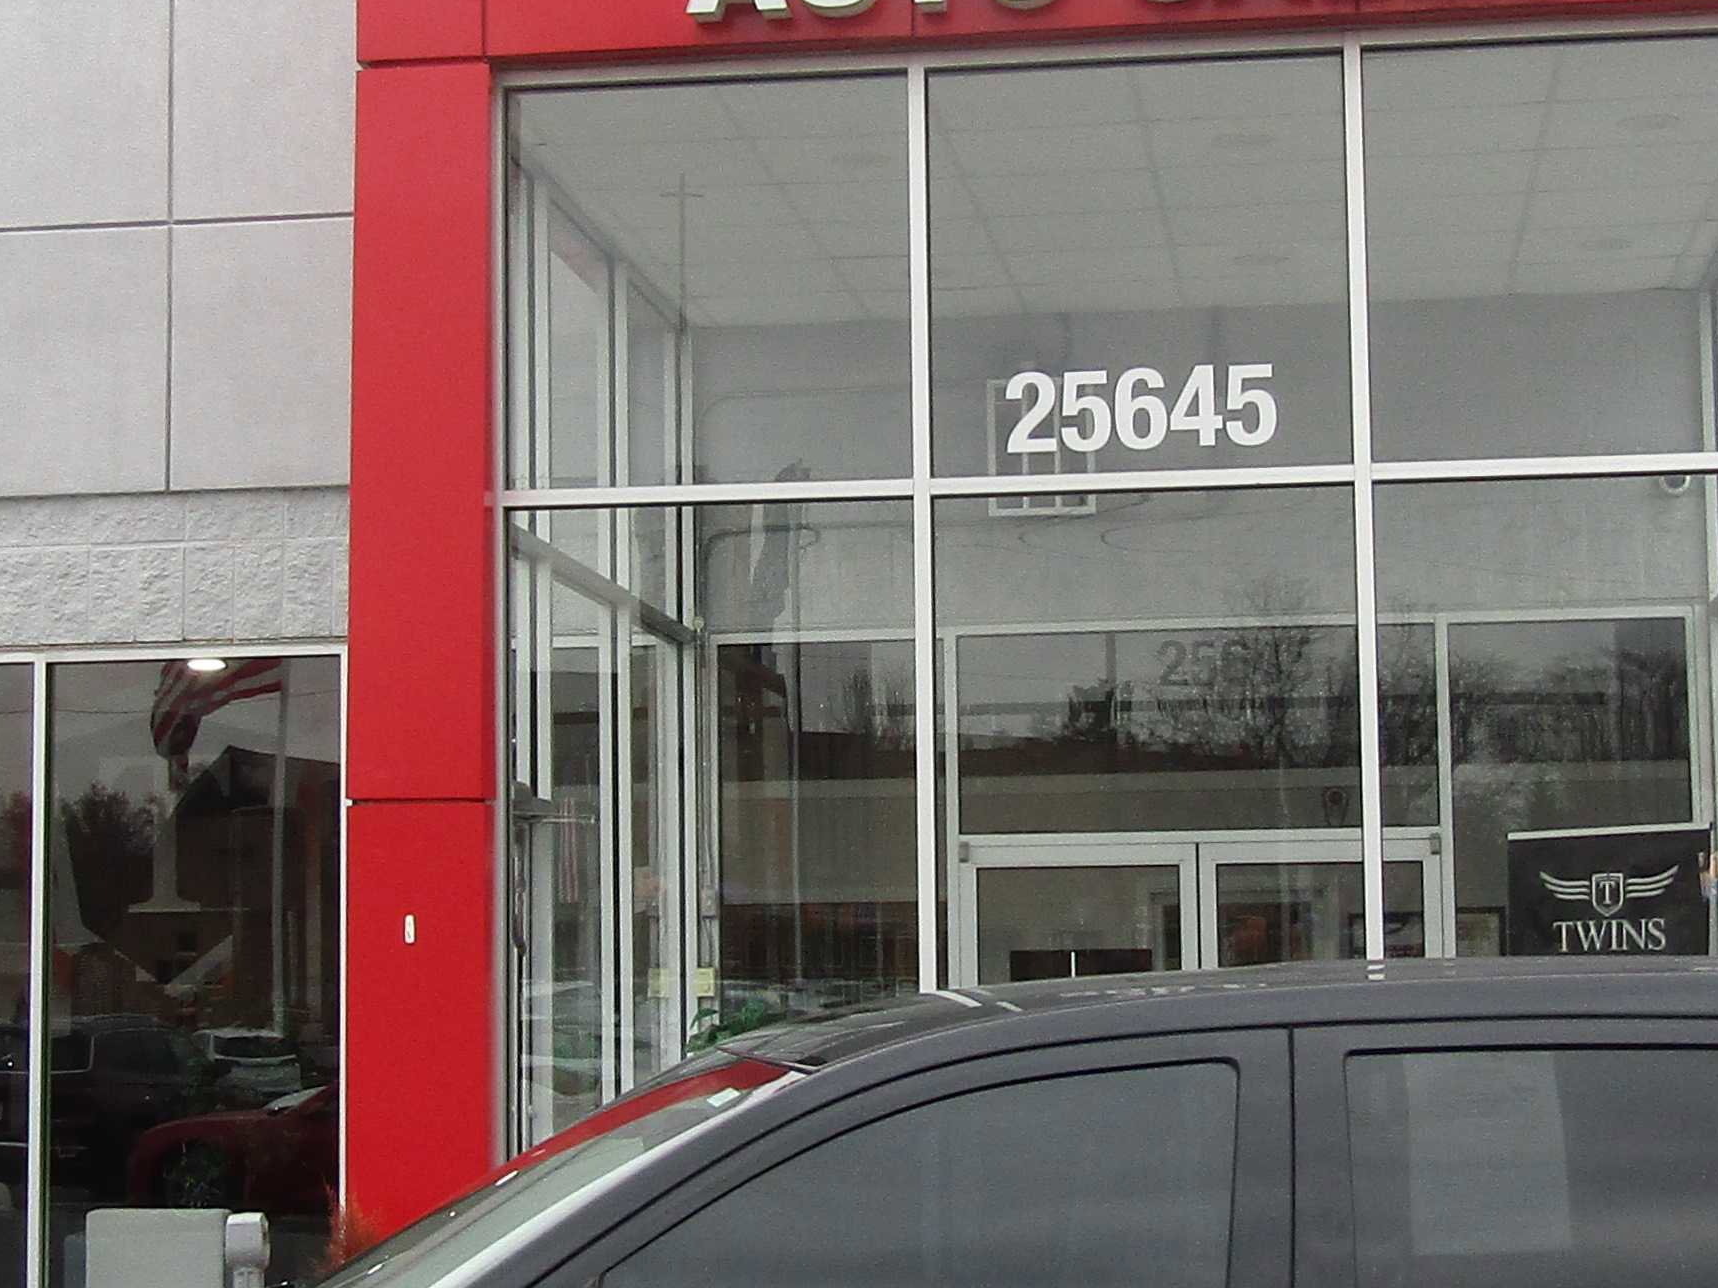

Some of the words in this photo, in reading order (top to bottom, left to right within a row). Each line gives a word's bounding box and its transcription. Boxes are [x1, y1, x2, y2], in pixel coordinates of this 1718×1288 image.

[1005, 363, 1277, 454] 25645
[1600, 880, 1616, 904] T
[1553, 918, 1666, 952] TWINS
